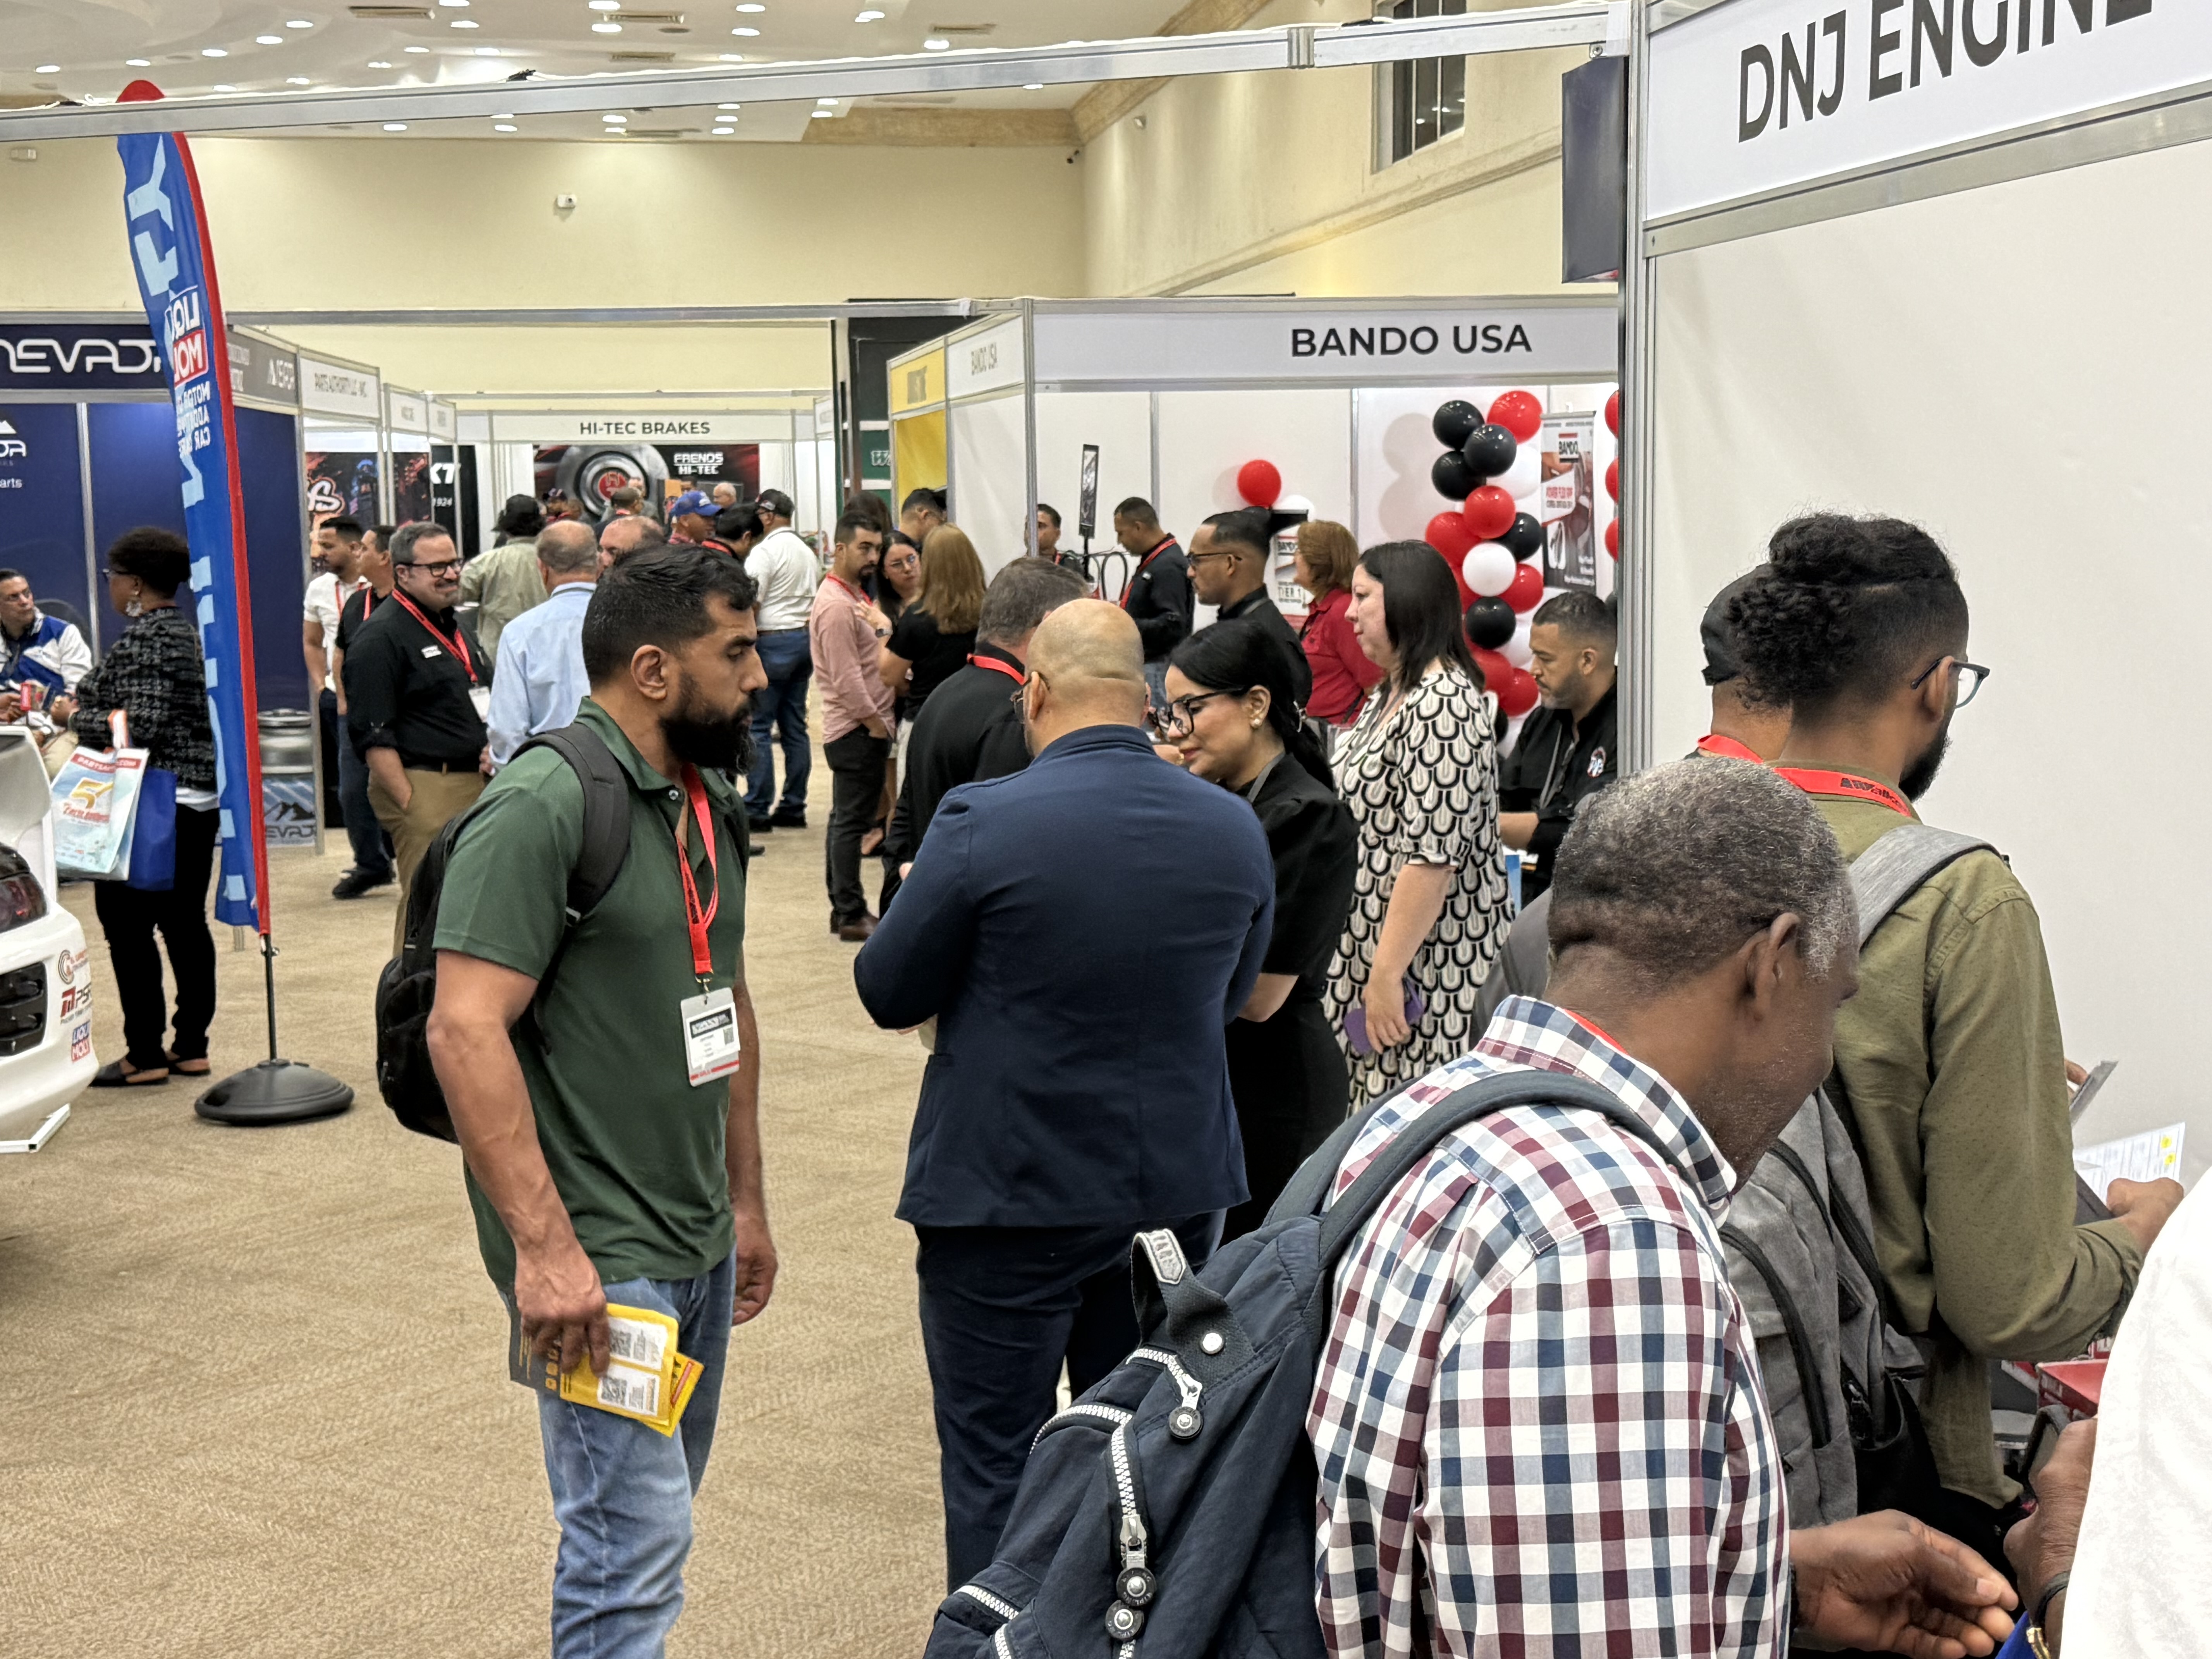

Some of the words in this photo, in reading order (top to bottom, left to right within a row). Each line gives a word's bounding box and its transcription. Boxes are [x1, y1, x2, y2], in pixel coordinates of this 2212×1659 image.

[1739, 9, 1846, 143] DNJ
[1869, 0, 2152, 101] ENG
[1292, 326, 1439, 357] BANDO
[1453, 324, 1532, 354] USA
[580, 422, 636, 435] HI-TEC
[641, 422, 711, 434] BRAKES
[674, 452, 723, 464] FRENOS
[678, 465, 719, 475] HI-TEC
[266, 824, 314, 839] EVAD
